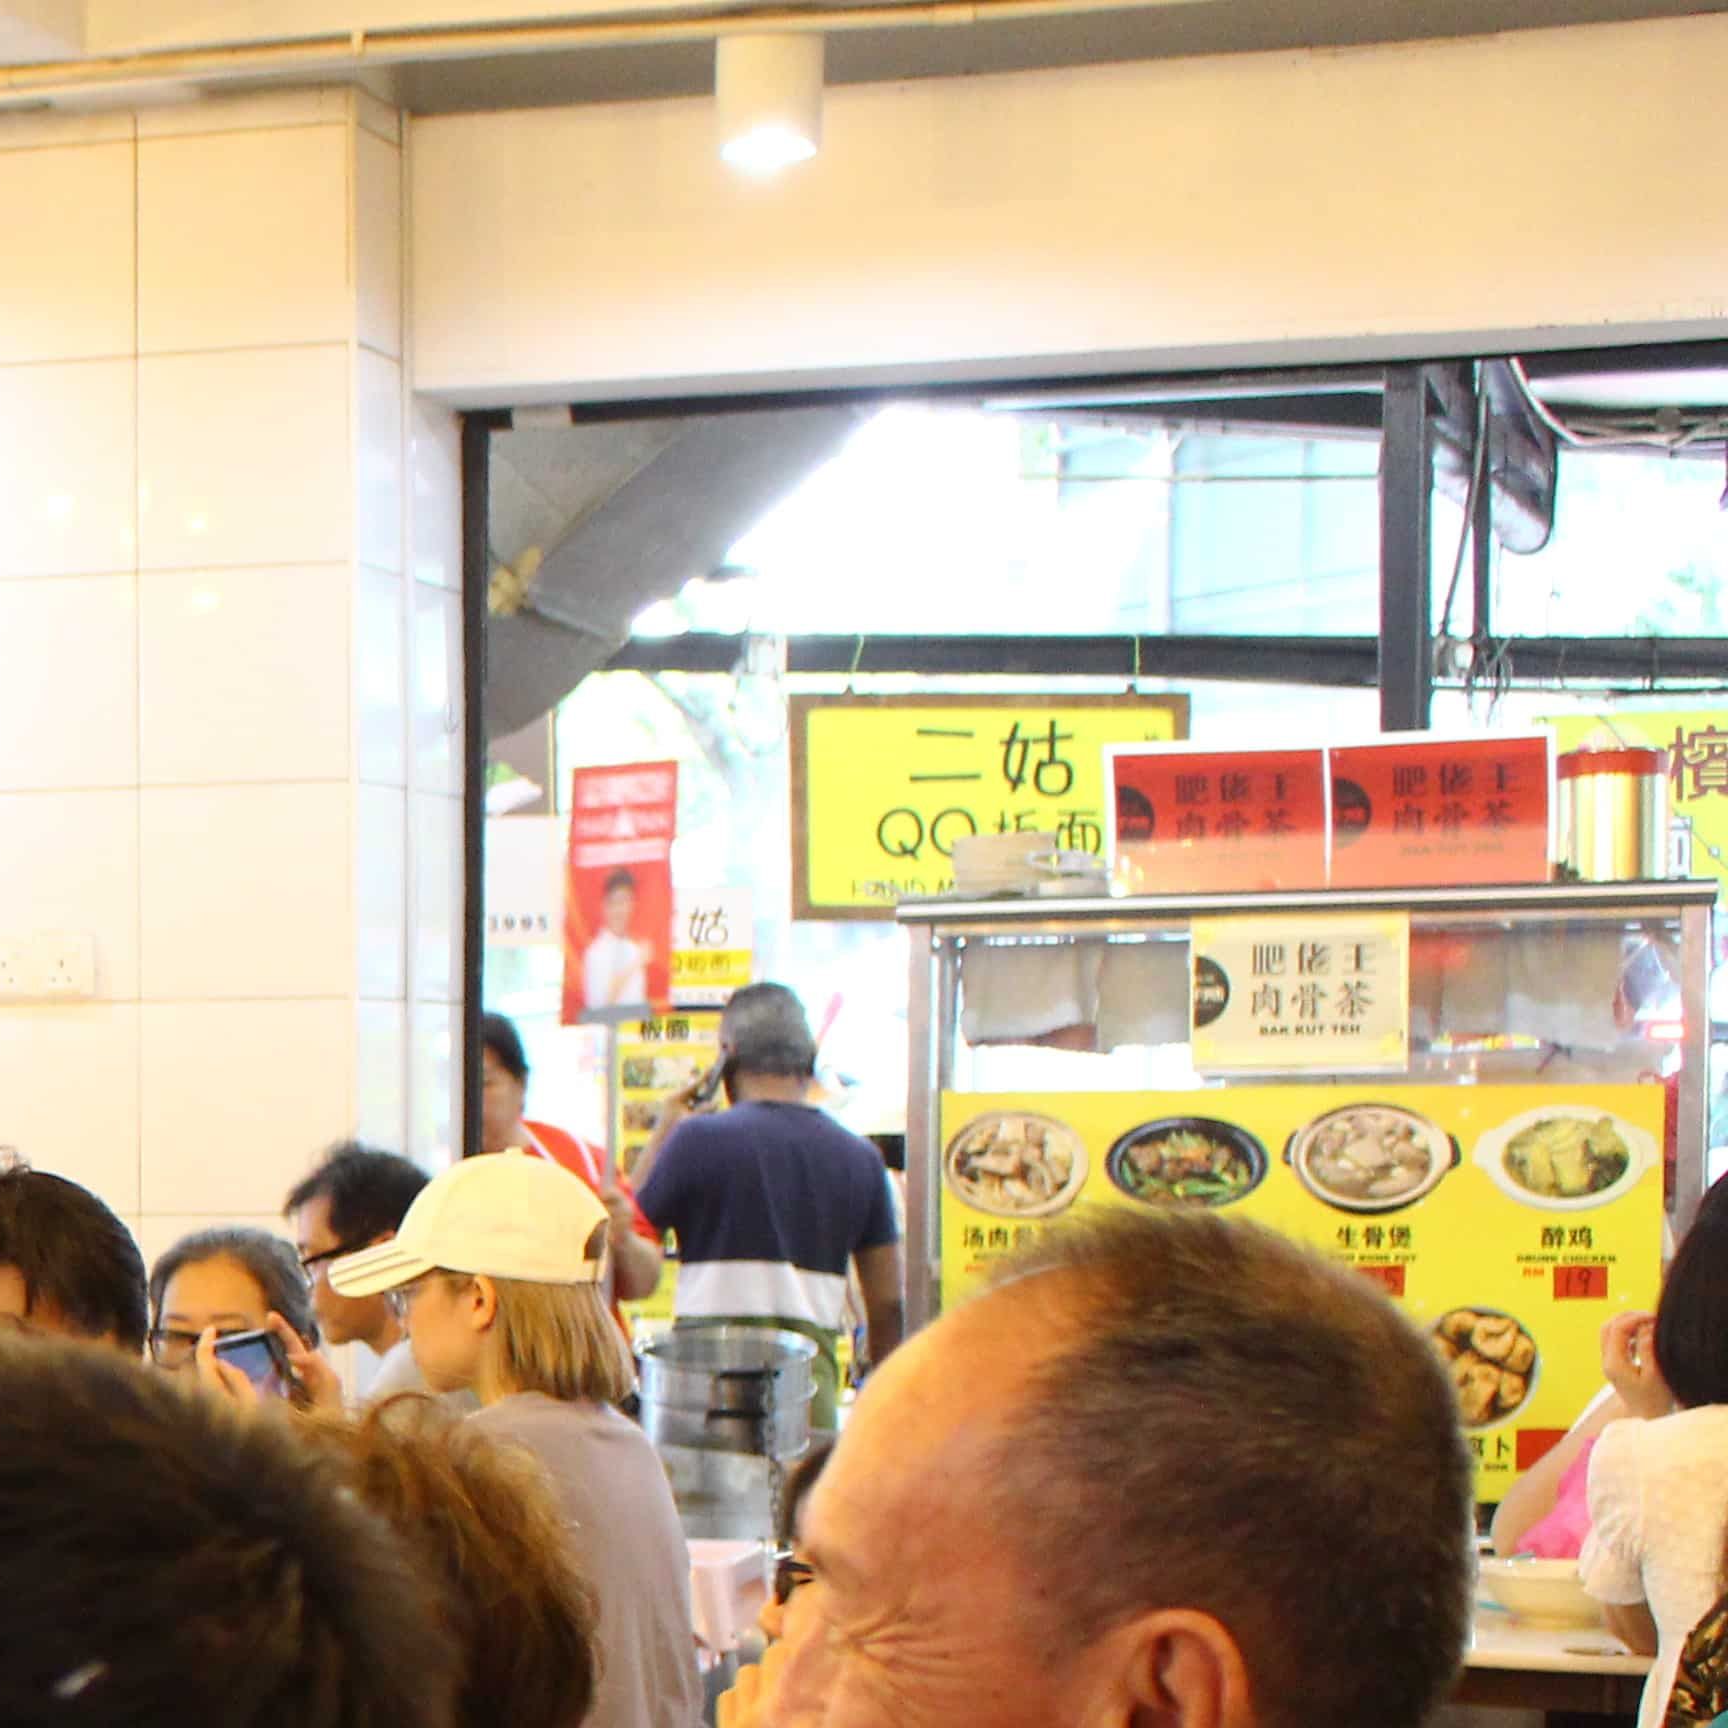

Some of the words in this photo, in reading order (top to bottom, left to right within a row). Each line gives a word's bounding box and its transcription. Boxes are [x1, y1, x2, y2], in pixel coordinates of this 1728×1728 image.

[909, 719, 1074, 797] 二姑
[1251, 942, 1377, 976] 肥佬王
[1250, 981, 1374, 1018] 肉骨茶
[1259, 1024, 1289, 1036] BAK
[1294, 1023, 1325, 1036] KUT
[1331, 1023, 1361, 1035] TEH
